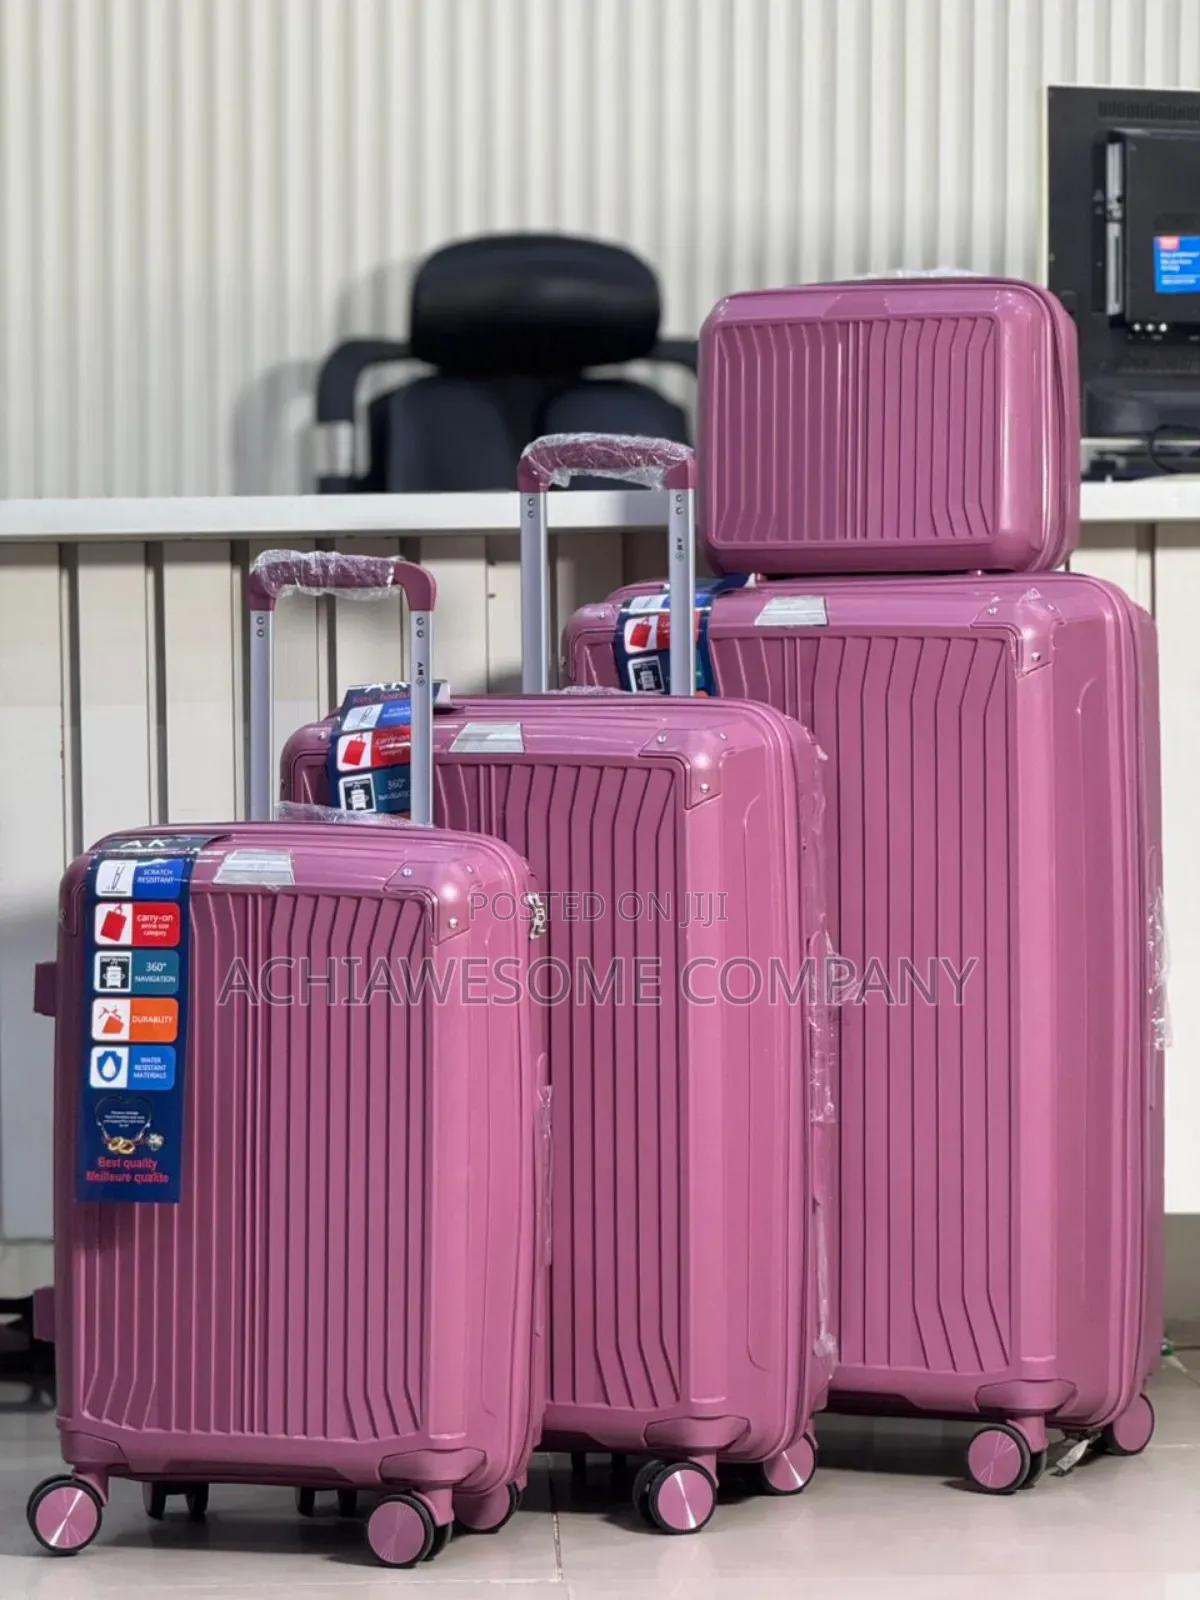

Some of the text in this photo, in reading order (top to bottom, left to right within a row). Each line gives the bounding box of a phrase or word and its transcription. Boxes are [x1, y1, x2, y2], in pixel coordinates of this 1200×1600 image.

[136, 914, 174, 924] carry-on
[134, 975, 176, 983] NAVIGATION
[140, 1056, 162, 1064] WATER
[133, 1071, 167, 1079] MATERIALS
[98, 1156, 158, 1171] Best quality
